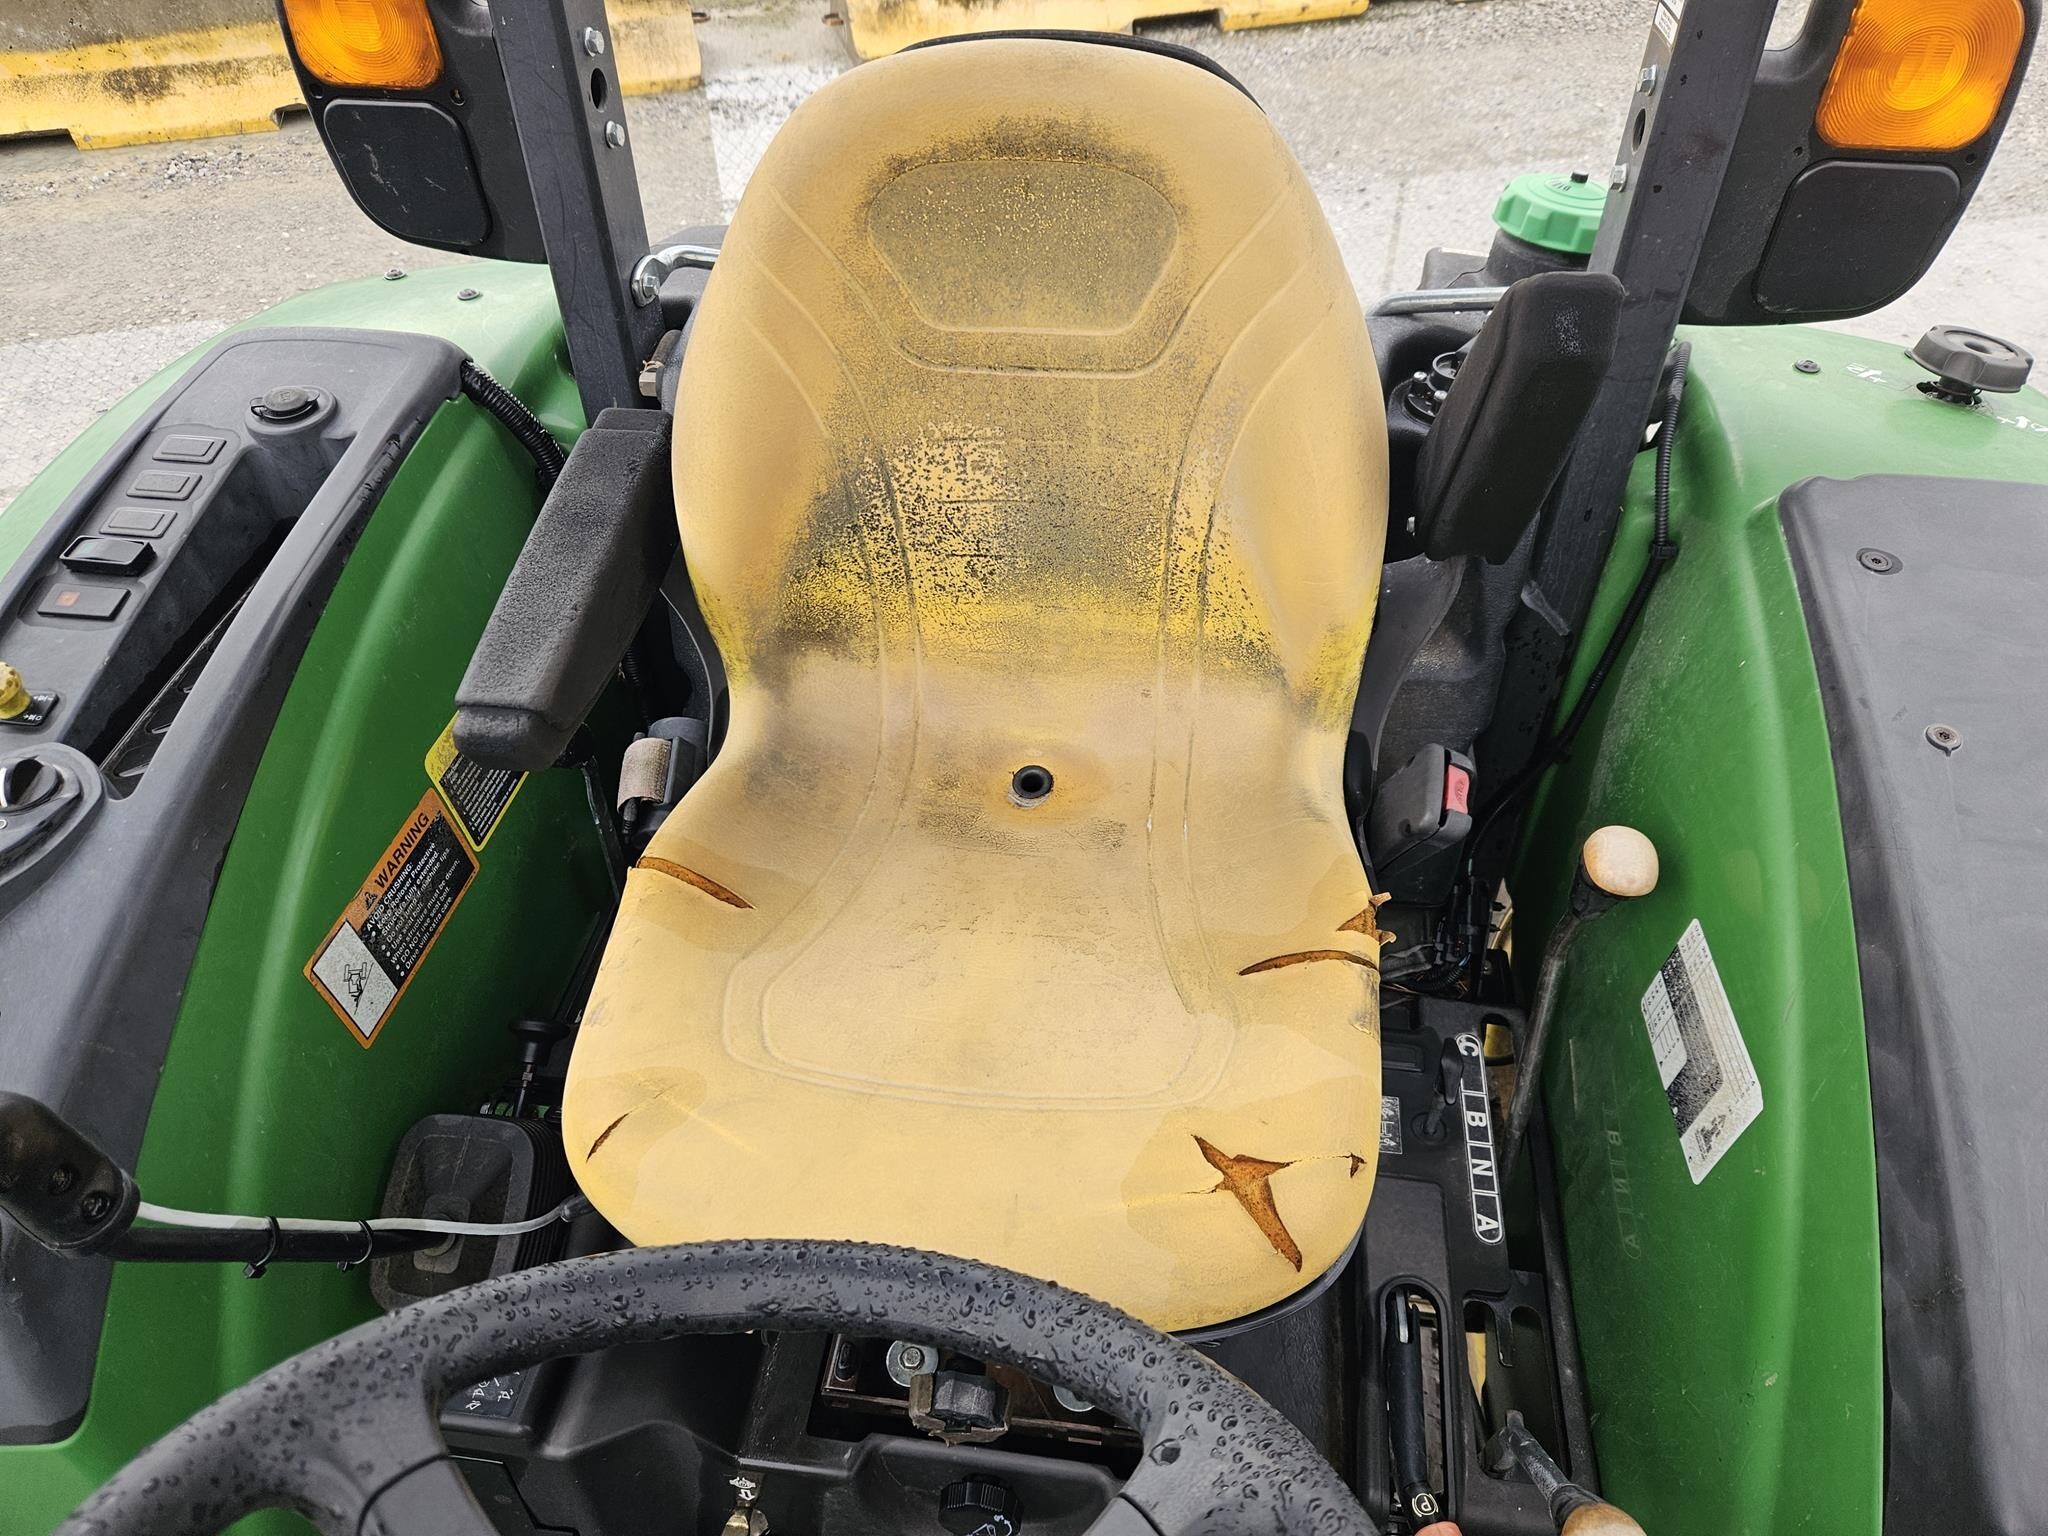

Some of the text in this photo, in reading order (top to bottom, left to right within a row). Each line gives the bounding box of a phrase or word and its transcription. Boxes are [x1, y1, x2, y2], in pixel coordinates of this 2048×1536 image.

[374, 810, 429, 891] WARNING
[390, 876, 412, 910] Rollover
[410, 840, 436, 879] Protective
[404, 882, 417, 903] fully
[415, 848, 439, 885] extended.
[365, 860, 413, 931] AVOID CRUSHING:
[390, 940, 406, 965] When
[404, 906, 427, 942] structure
[426, 887, 440, 909] must
[438, 878, 446, 890] be
[391, 931, 403, 950] Use
[400, 947, 410, 963] DO
[408, 929, 422, 950] NOT
[420, 915, 431, 932] use
[428, 899, 440, 918] seat
[405, 946, 419, 969] Drive
[417, 929, 430, 949] with
[1460, 1041, 1479, 1057] C
[1466, 1111, 1487, 1127] B
[1471, 1158, 1493, 1176] N
[1476, 1213, 1499, 1233] A
[1421, 1496, 1432, 1511] P
